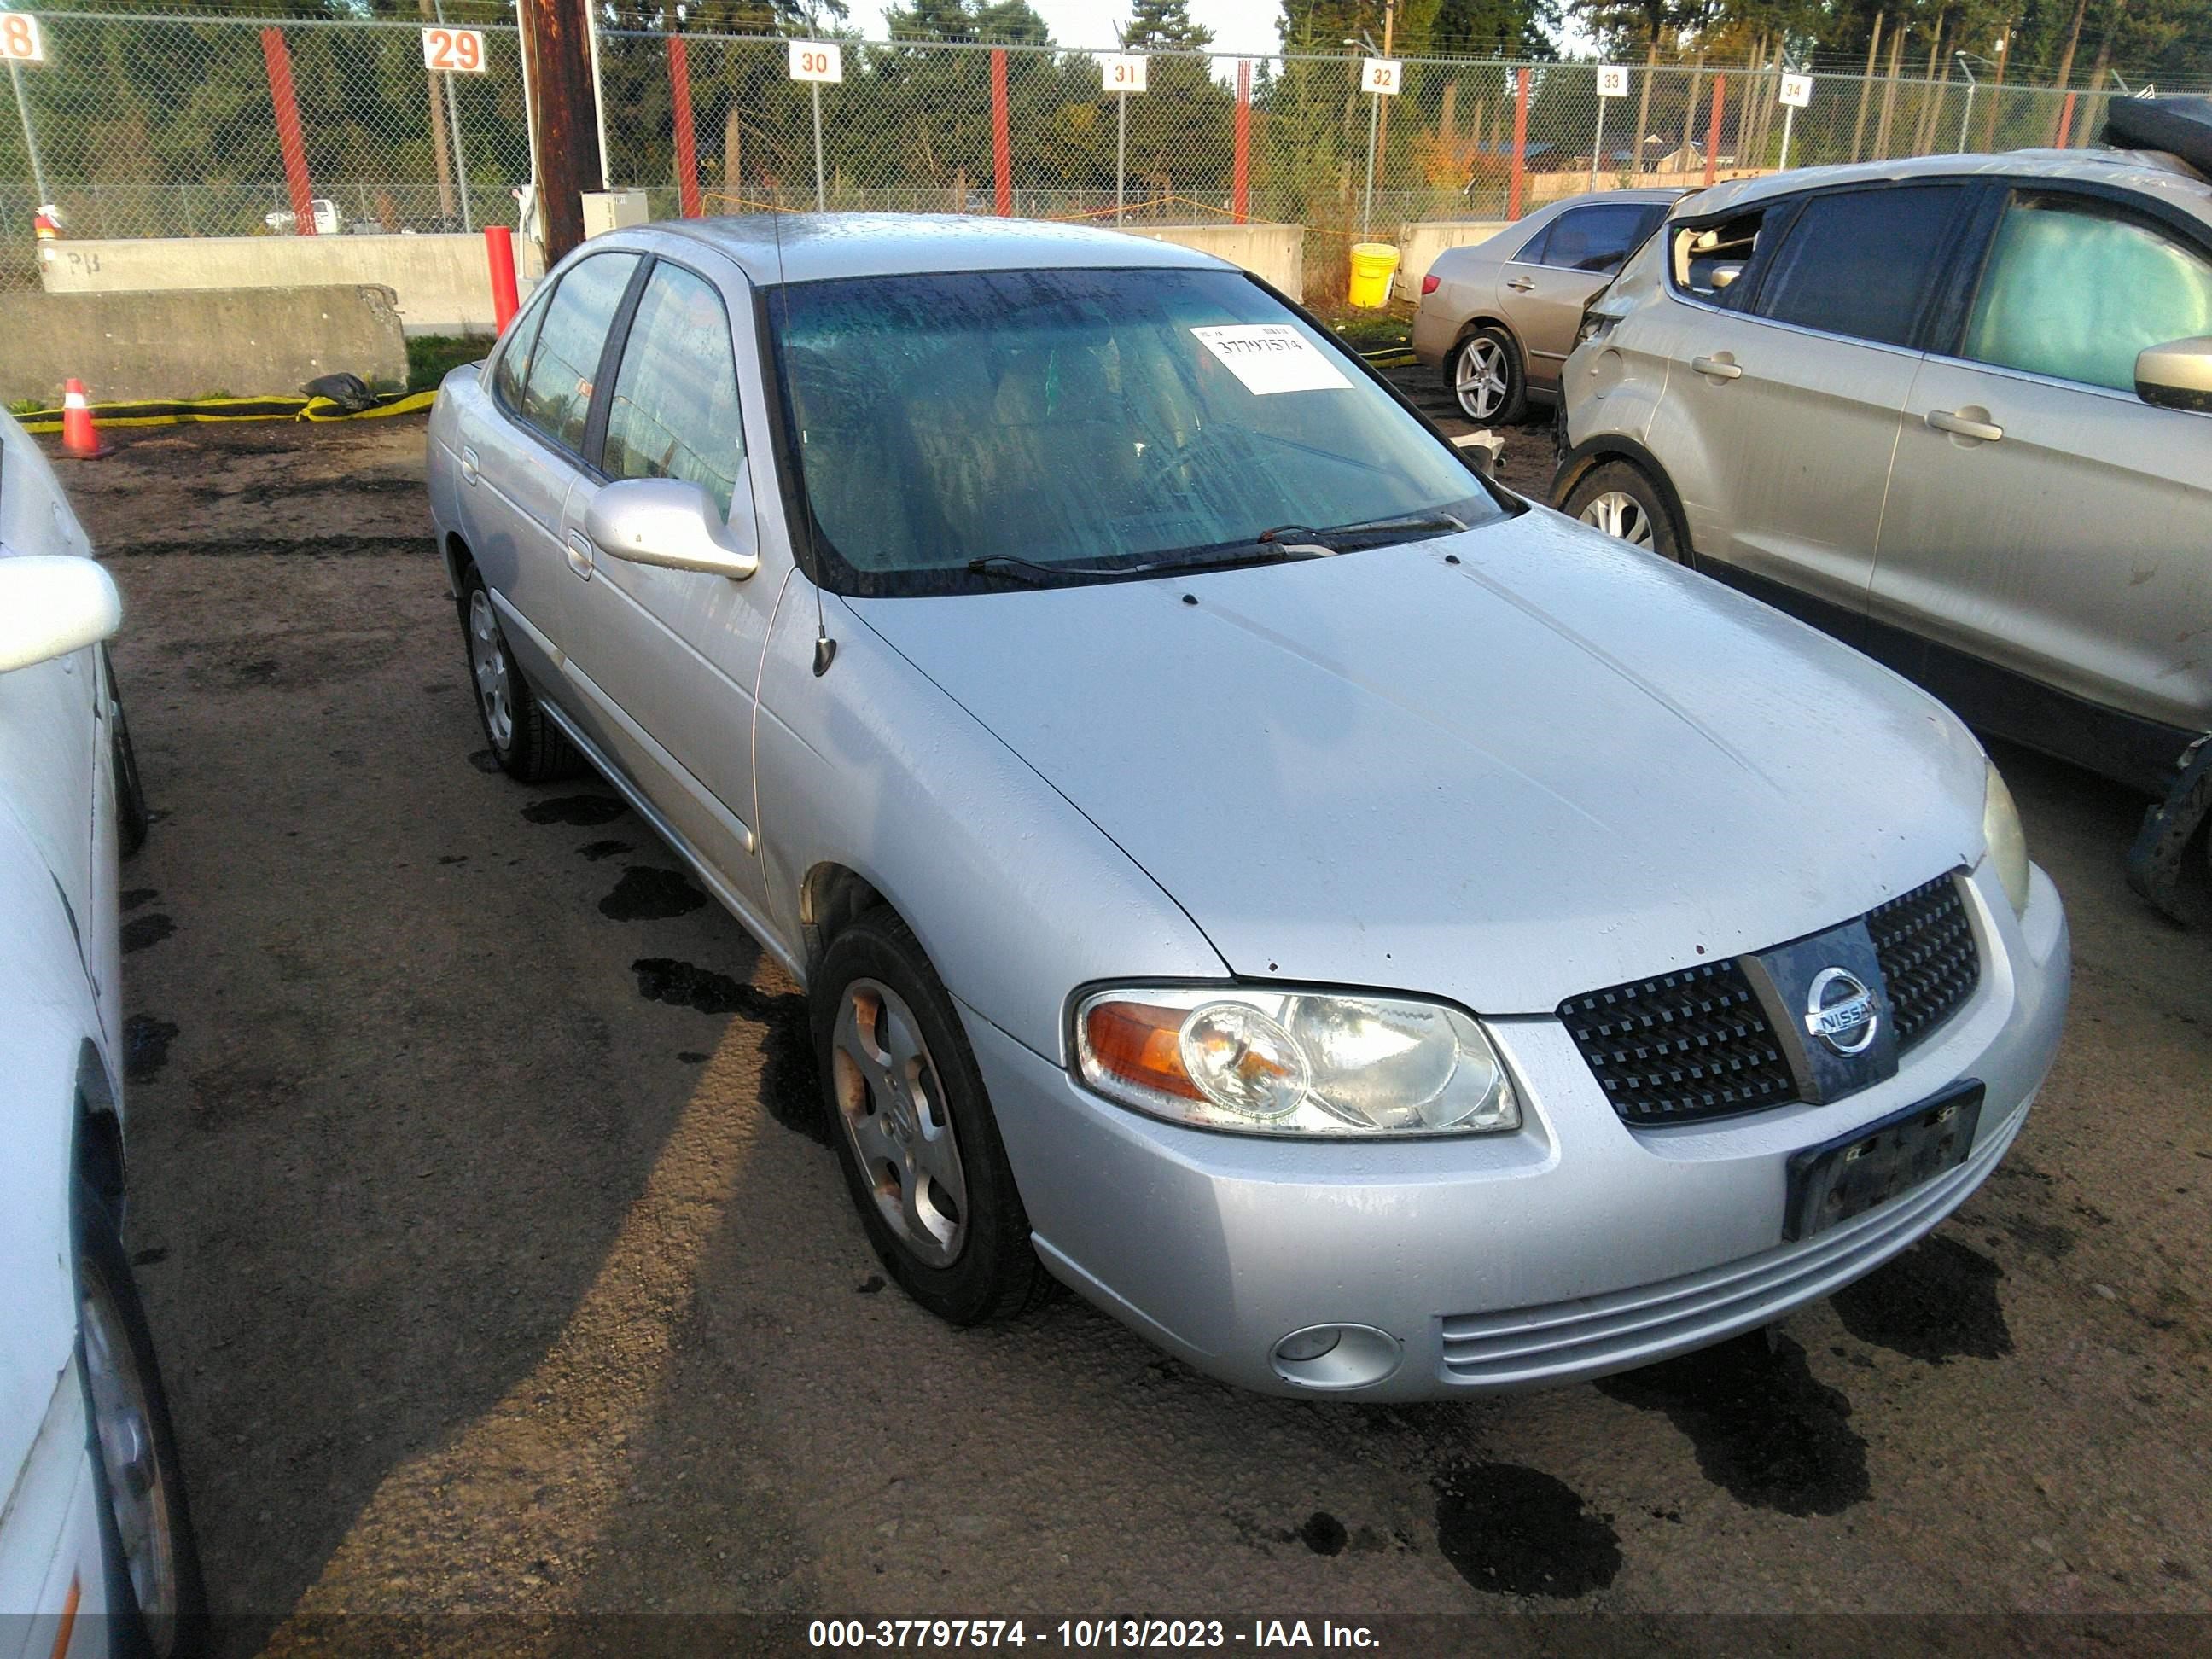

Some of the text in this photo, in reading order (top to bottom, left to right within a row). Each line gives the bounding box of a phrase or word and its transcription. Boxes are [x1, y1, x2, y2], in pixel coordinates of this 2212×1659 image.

[0, 15, 33, 56] 8
[429, 30, 479, 69] 29
[802, 52, 827, 73] 30
[1115, 65, 1134, 83] 31
[1373, 68, 1391, 86] 32
[1604, 74, 1619, 89] 33
[1786, 83, 1801, 97] 34
[1217, 339, 1303, 354] 37797574
